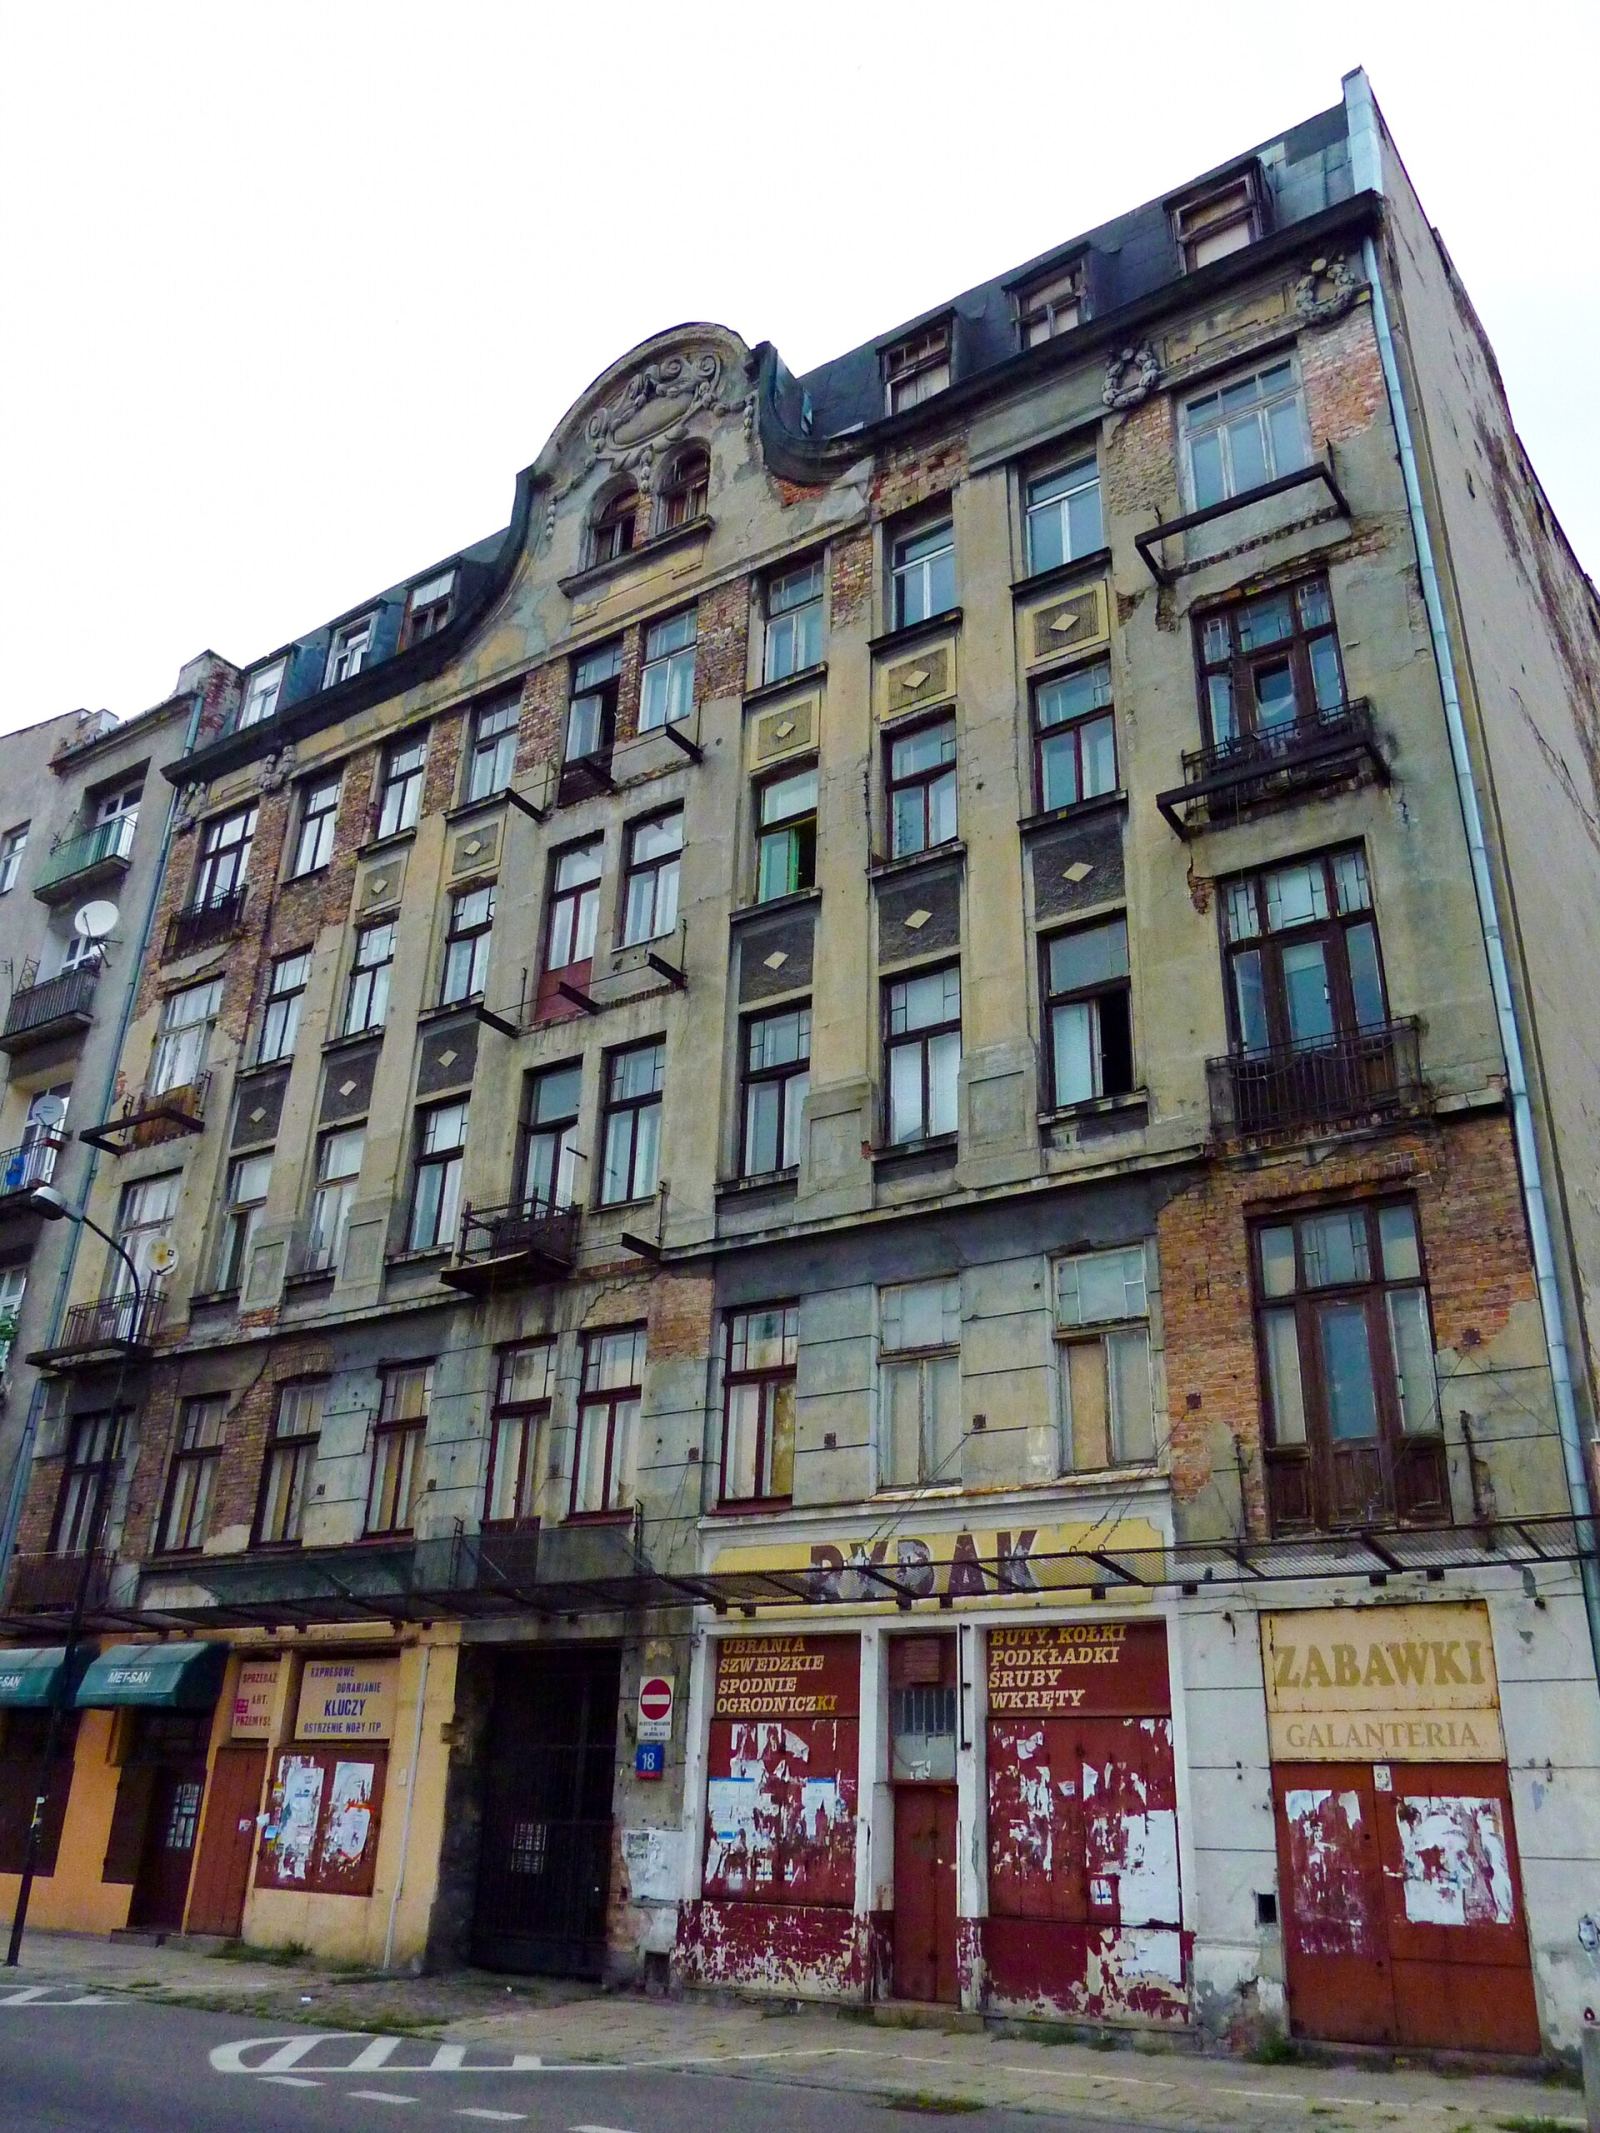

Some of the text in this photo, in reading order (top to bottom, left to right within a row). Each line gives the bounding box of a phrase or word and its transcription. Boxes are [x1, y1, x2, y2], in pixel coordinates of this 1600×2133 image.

[811, 1530, 1038, 1600] RYBAK
[722, 1637, 805, 1653] UBRANIA
[990, 1627, 1054, 1648] BUTY,
[719, 1655, 824, 1673] SZWEDZKIE
[990, 1647, 1120, 1666] PODKŁADKI
[1275, 1640, 1486, 1688] ZABAWKI
[107, 1671, 151, 1683] MET-SAN
[310, 1666, 355, 1677] EXPRESOWE
[988, 1667, 1062, 1688] ŚRUBY
[336, 1682, 381, 1693] DORABIANIE
[718, 1677, 797, 1694] SPODNIE
[324, 1699, 366, 1716] KLUCZY
[716, 1695, 838, 1713] OGRODNICZKI
[989, 1689, 1085, 1711] WKRĘTY
[304, 1722, 342, 1733] OSTRZENIE
[1286, 1721, 1480, 1748] GALANTERIA
[642, 1752, 655, 1770] 18
